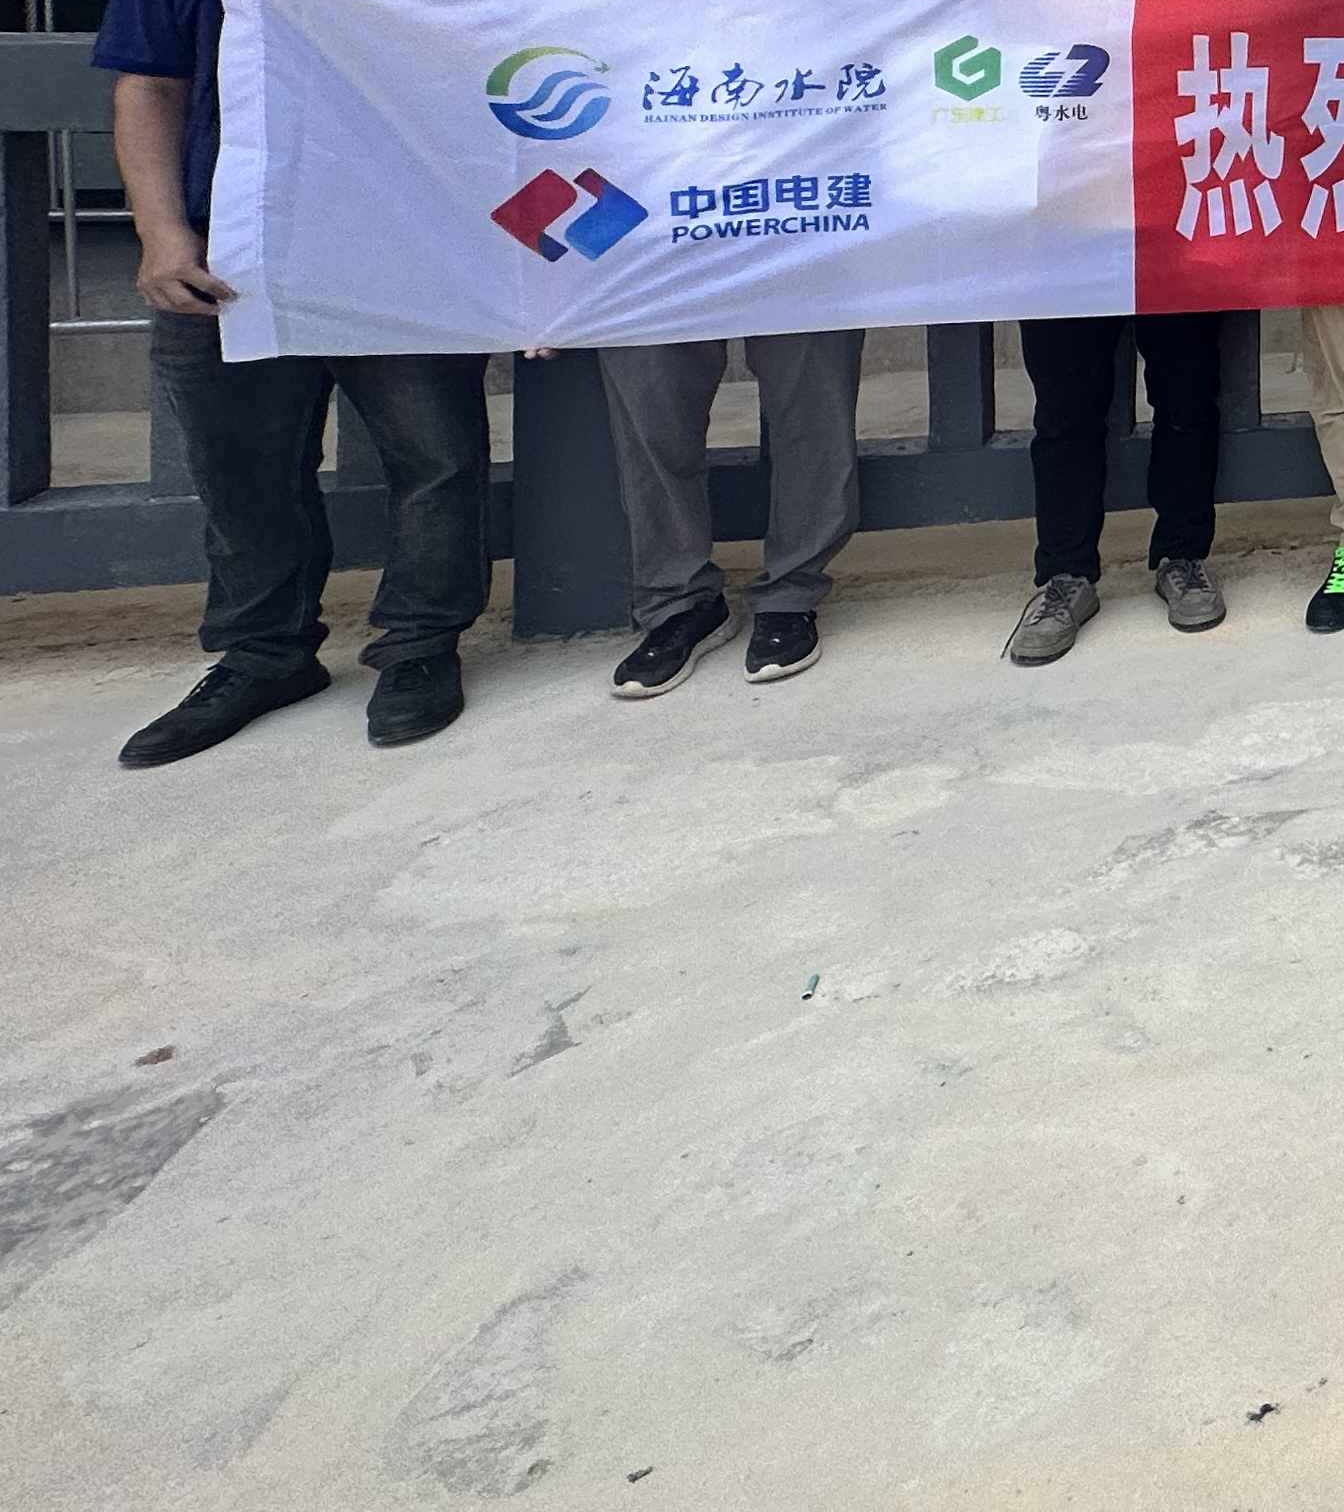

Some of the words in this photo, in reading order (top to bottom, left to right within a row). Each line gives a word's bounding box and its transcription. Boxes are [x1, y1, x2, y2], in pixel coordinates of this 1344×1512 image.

[642, 62, 886, 110] 海南水院
[644, 114, 698, 124] HAINAN
[699, 112, 750, 123] DESIGN
[752, 107, 823, 120] INSTITUTE
[824, 105, 842, 114] OF
[844, 103, 887, 113] WATER
[1035, 104, 1088, 122] 粤水电
[670, 173, 872, 219] 中国电建
[671, 214, 870, 243] POWERCHINA
